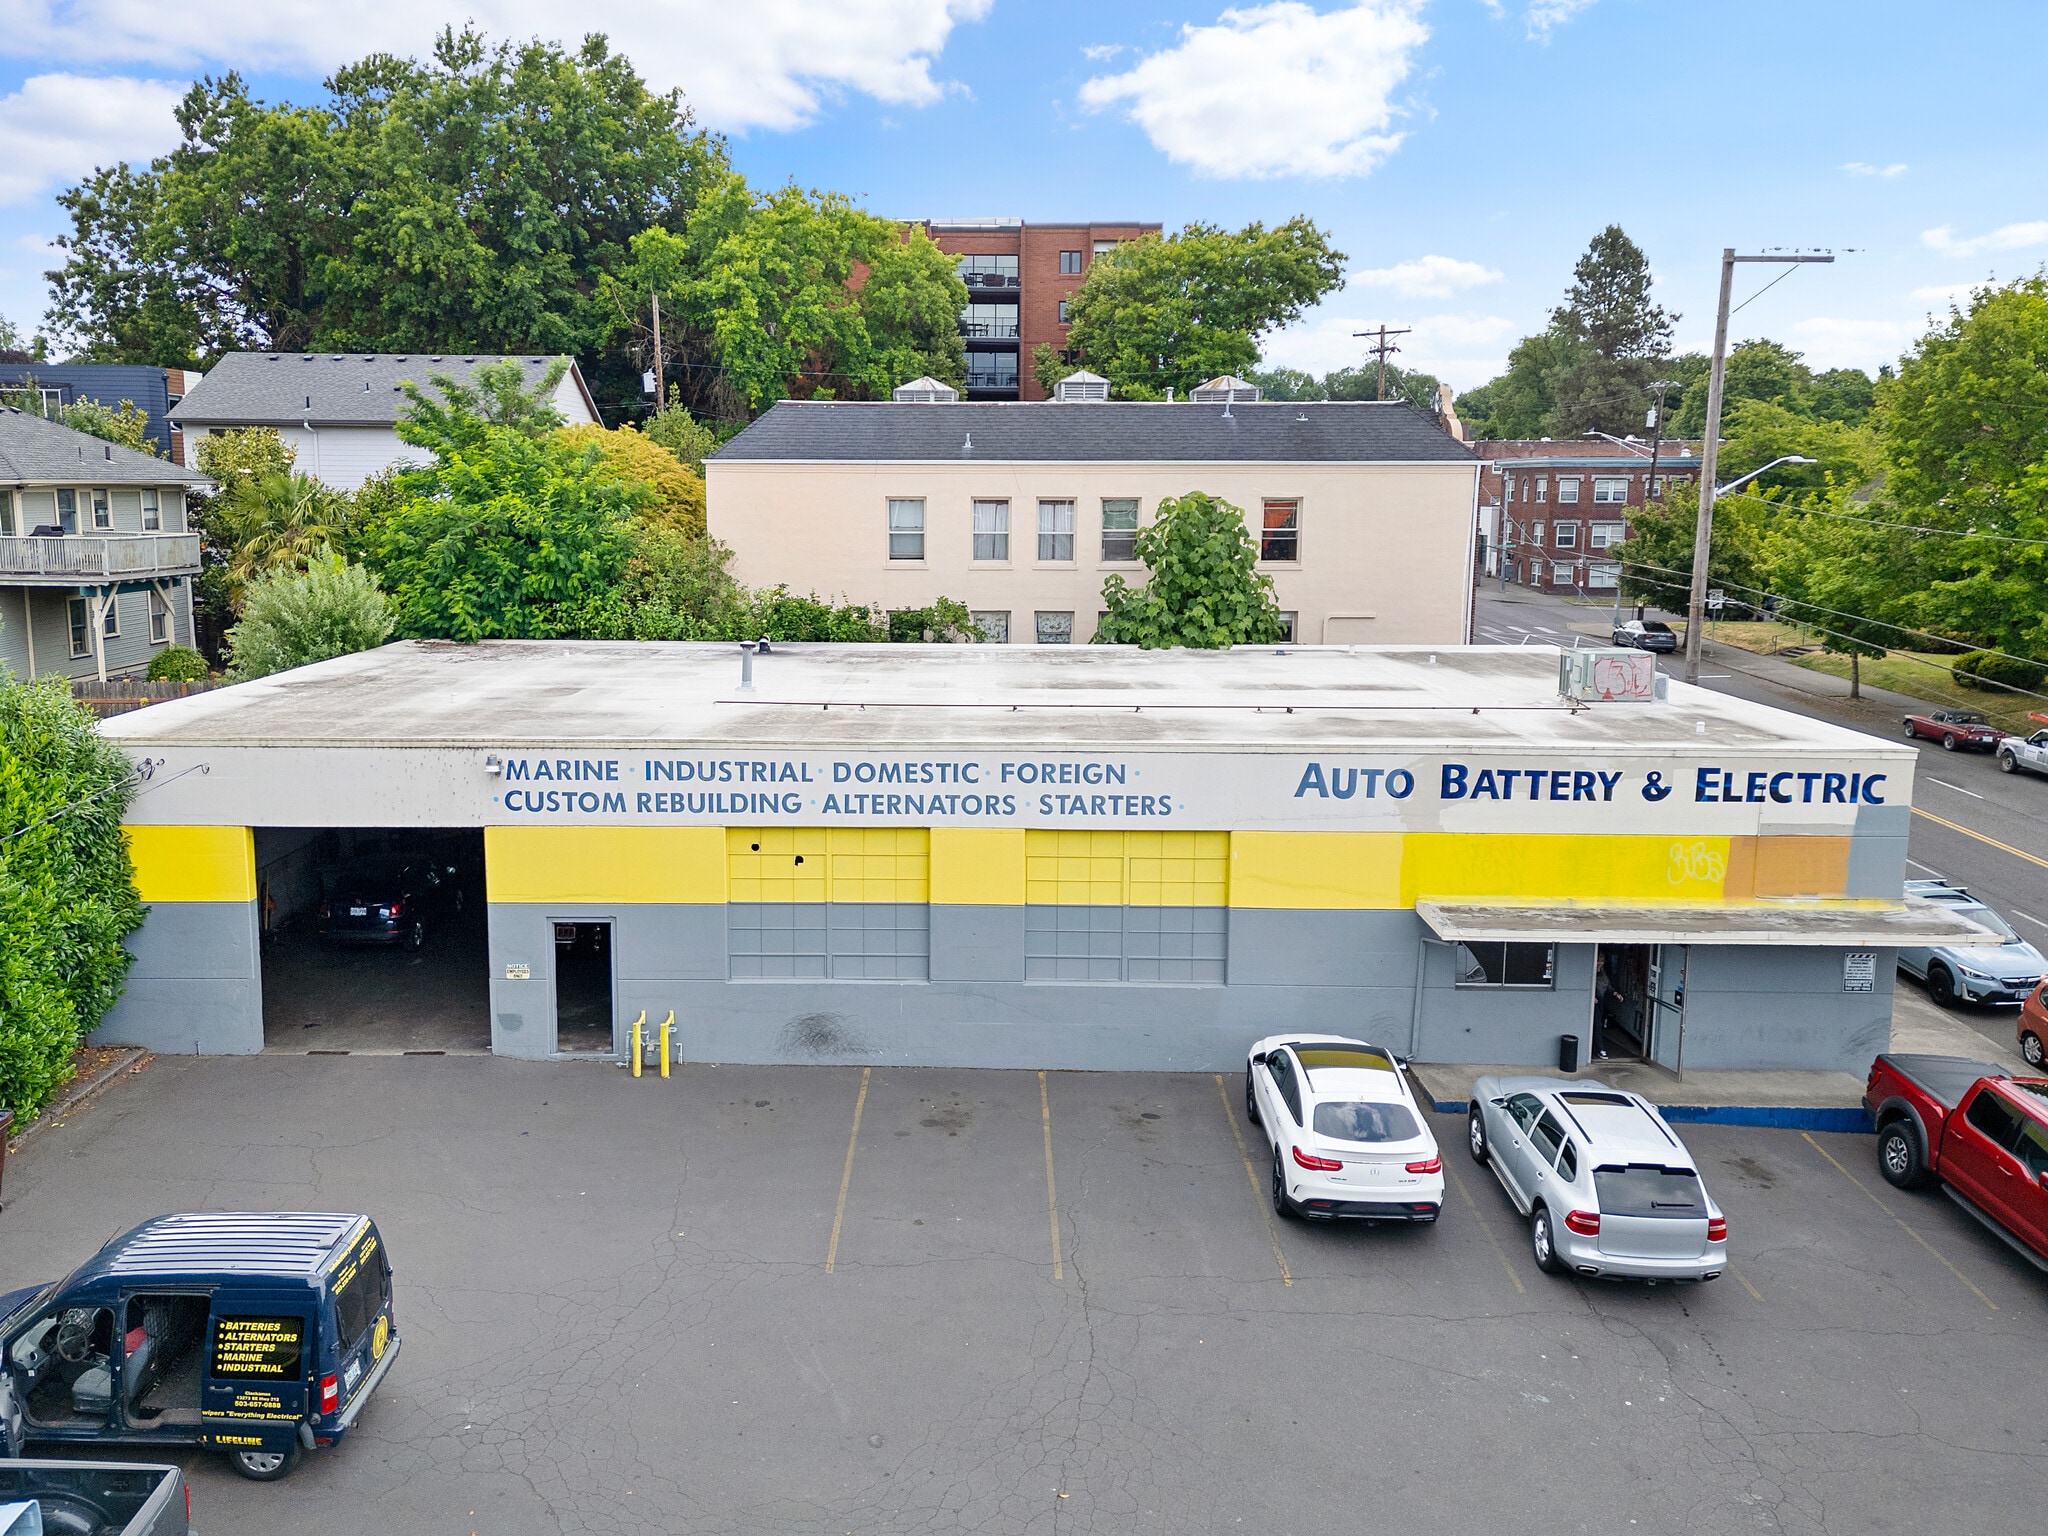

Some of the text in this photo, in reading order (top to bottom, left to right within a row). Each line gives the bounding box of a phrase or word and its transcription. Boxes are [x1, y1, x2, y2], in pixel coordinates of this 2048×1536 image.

[506, 760, 1126, 785] MARINE INDUSTRIAL DOMESTIC FOREIGN
[1293, 762, 1887, 806] AUTO BATTERY & ELECTRIC
[504, 790, 1172, 816] CUSTOM REBUILDING ALTERNATORS STARTERS
[225, 1322, 281, 1332] BATTERIES
[224, 1332, 298, 1343] ALTERNATORS
[223, 1342, 276, 1353] STARTERS
[222, 1352, 264, 1363] MARINE
[222, 1363, 284, 1374] INDUSTRIAL
[226, 1410, 266, 1420] "Everything
[266, 1411, 304, 1421] Electrical"
[215, 1435, 263, 1446] LIFELINE
